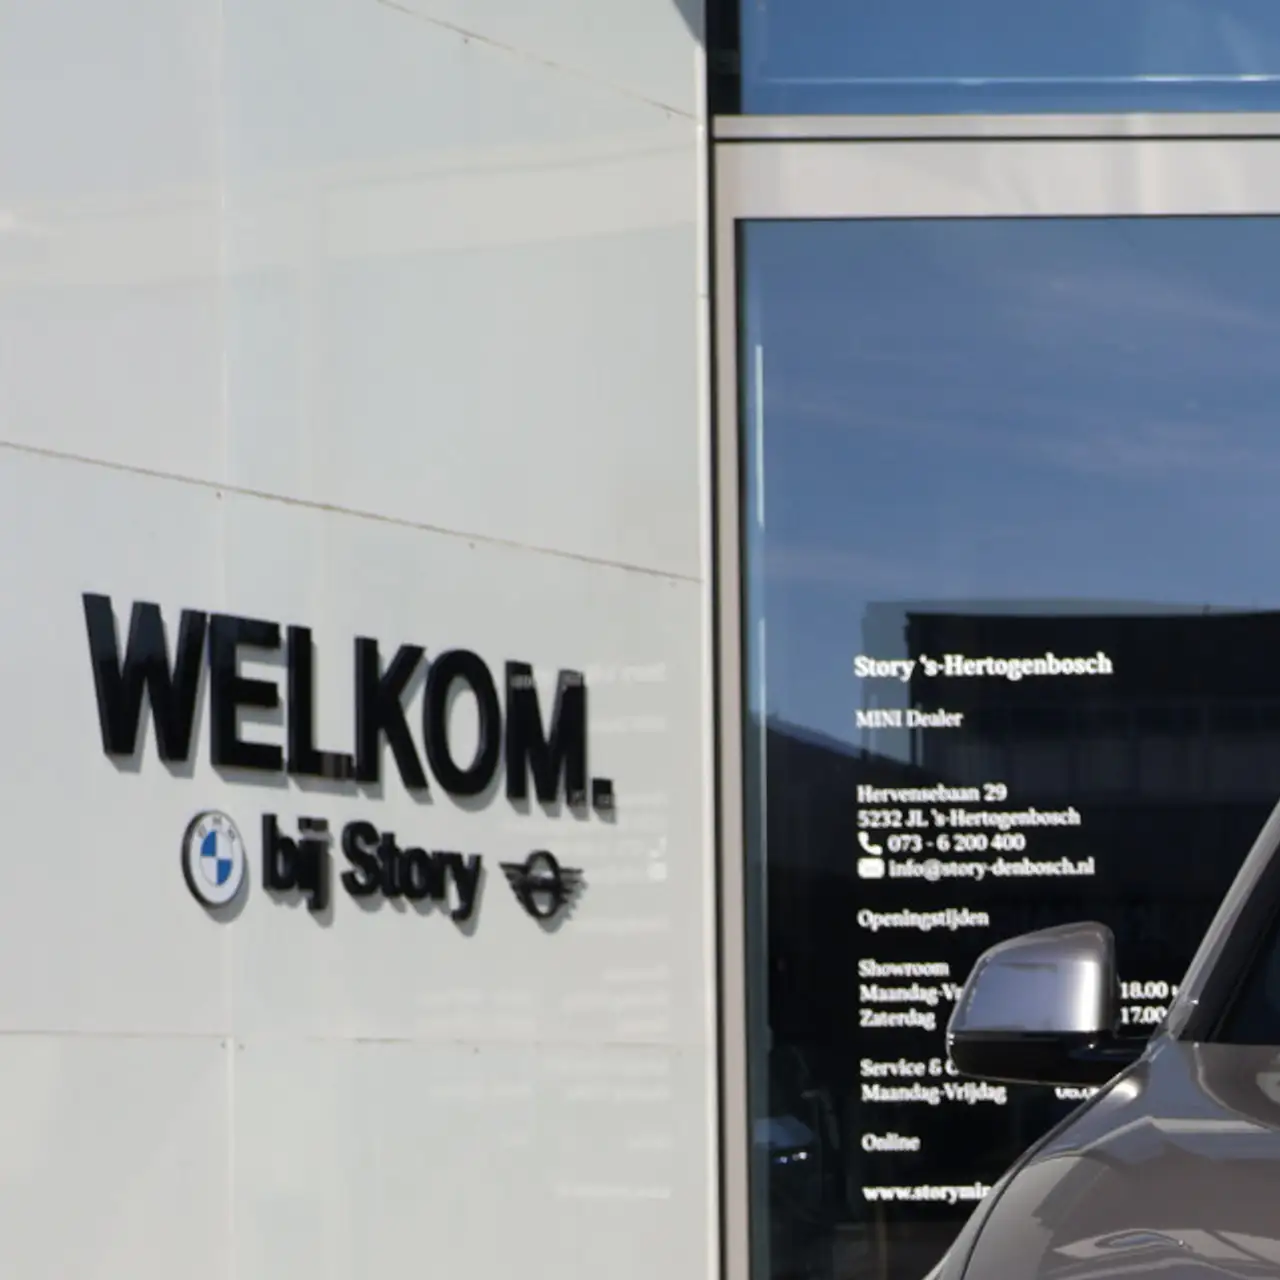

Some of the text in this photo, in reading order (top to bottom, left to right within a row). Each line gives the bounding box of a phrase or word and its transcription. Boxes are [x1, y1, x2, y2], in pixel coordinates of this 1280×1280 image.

[854, 652, 1113, 682] Story 's-Hertogenbosch
[82, 593, 613, 809] WELKOM.
[856, 709, 963, 729] MINI Dealer
[983, 782, 1008, 802] 29
[857, 807, 1082, 831] 5232 JL 's-Hertogenbosch
[887, 834, 923, 853] 073
[936, 834, 950, 852] 6
[953, 834, 988, 852] 200
[990, 833, 1026, 852] 400
[262, 814, 482, 921] bij Story
[888, 857, 1096, 881] info@story-denbosch.nl
[857, 908, 989, 932] Openingstijden
[859, 959, 949, 977] Showroom
[1121, 980, 1168, 999] 18.00
[860, 1008, 936, 1030] Zaterdag
[860, 1058, 925, 1076] Service
[928, 1057, 942, 1076] &
[862, 1082, 1007, 1105] Maandag-Vrijdag
[862, 1132, 920, 1151] Online
